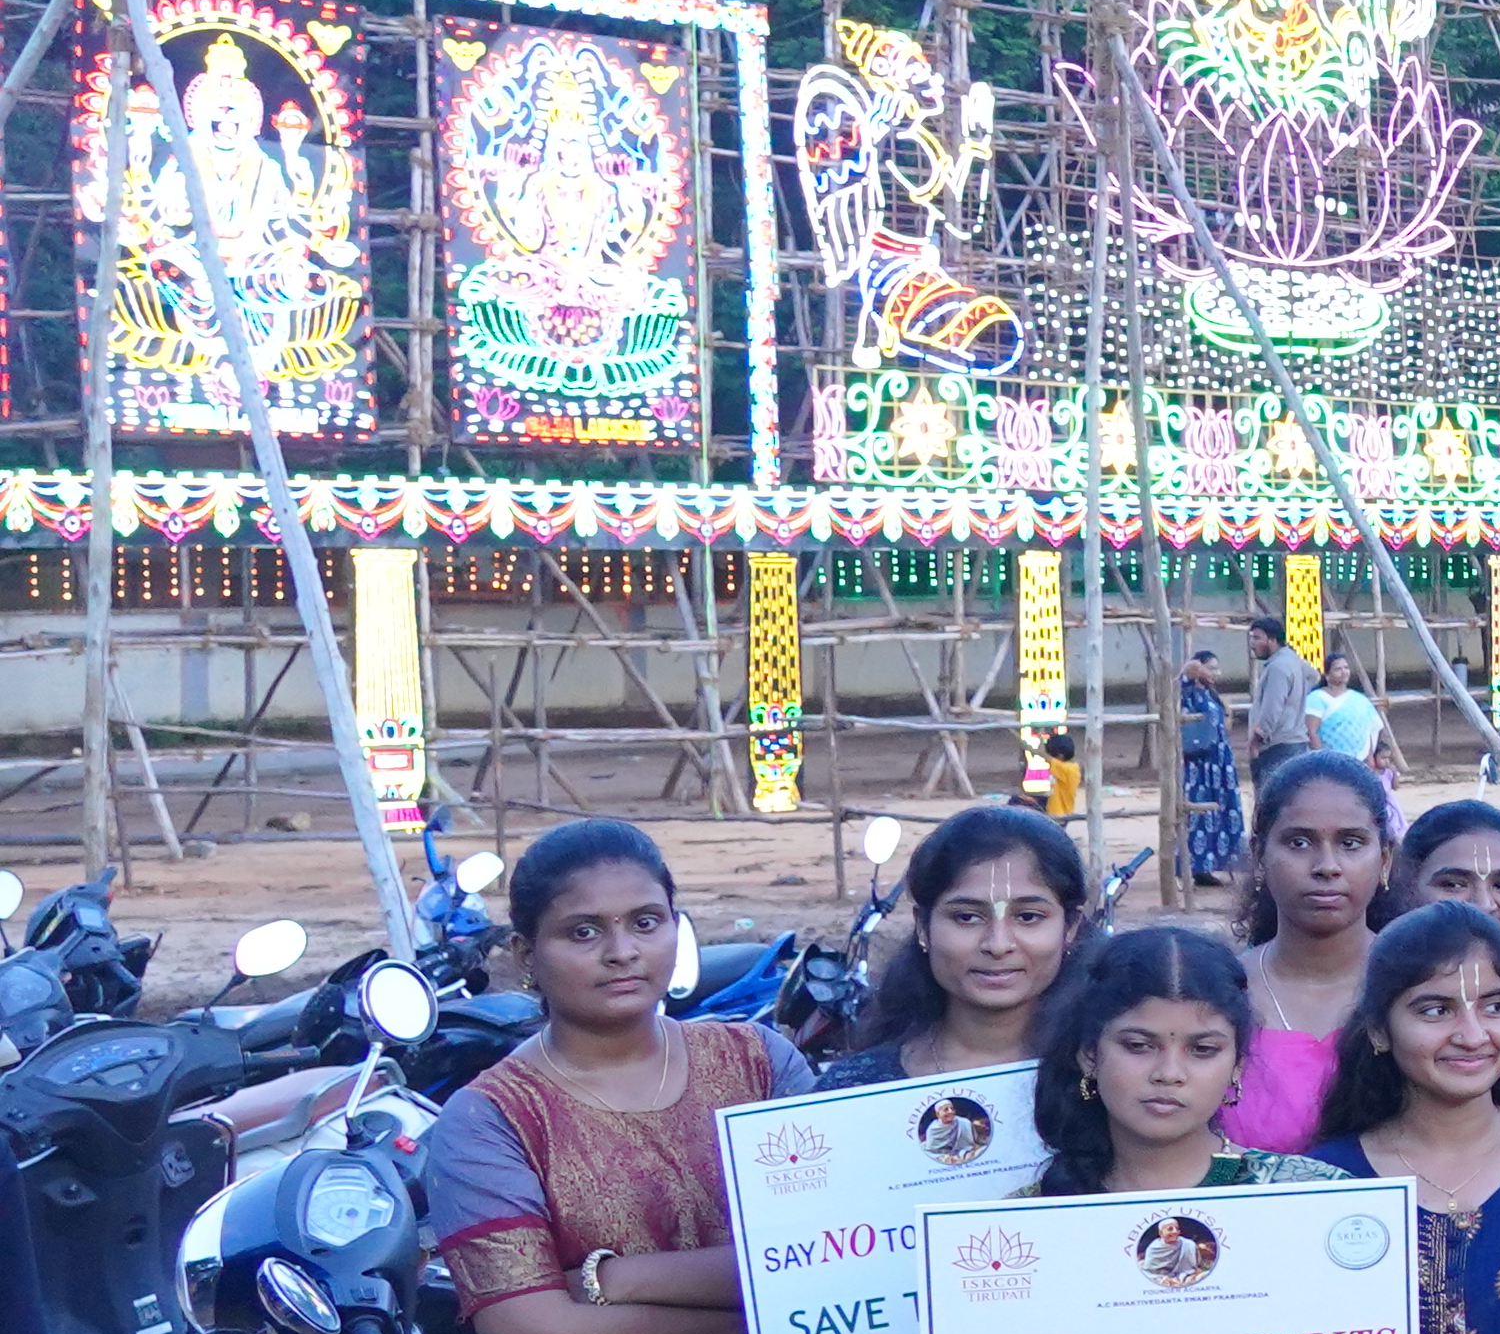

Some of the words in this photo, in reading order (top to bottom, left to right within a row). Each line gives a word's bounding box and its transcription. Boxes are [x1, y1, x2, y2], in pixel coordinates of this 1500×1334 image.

[905, 1089, 945, 1139] ABHAY
[952, 1086, 1003, 1125] UTSAV
[764, 1165, 828, 1185] ISKCON
[770, 1178, 828, 1197] TIRUPATI
[1123, 1207, 1172, 1257] ABHAY
[1180, 1206, 1230, 1250] UTSAV
[762, 1240, 818, 1273] SAY
[816, 1222, 879, 1264] NO
[880, 1224, 916, 1254] TO
[961, 1275, 1032, 1290] ISKCON
[966, 1288, 1031, 1303] TIRUPATI
